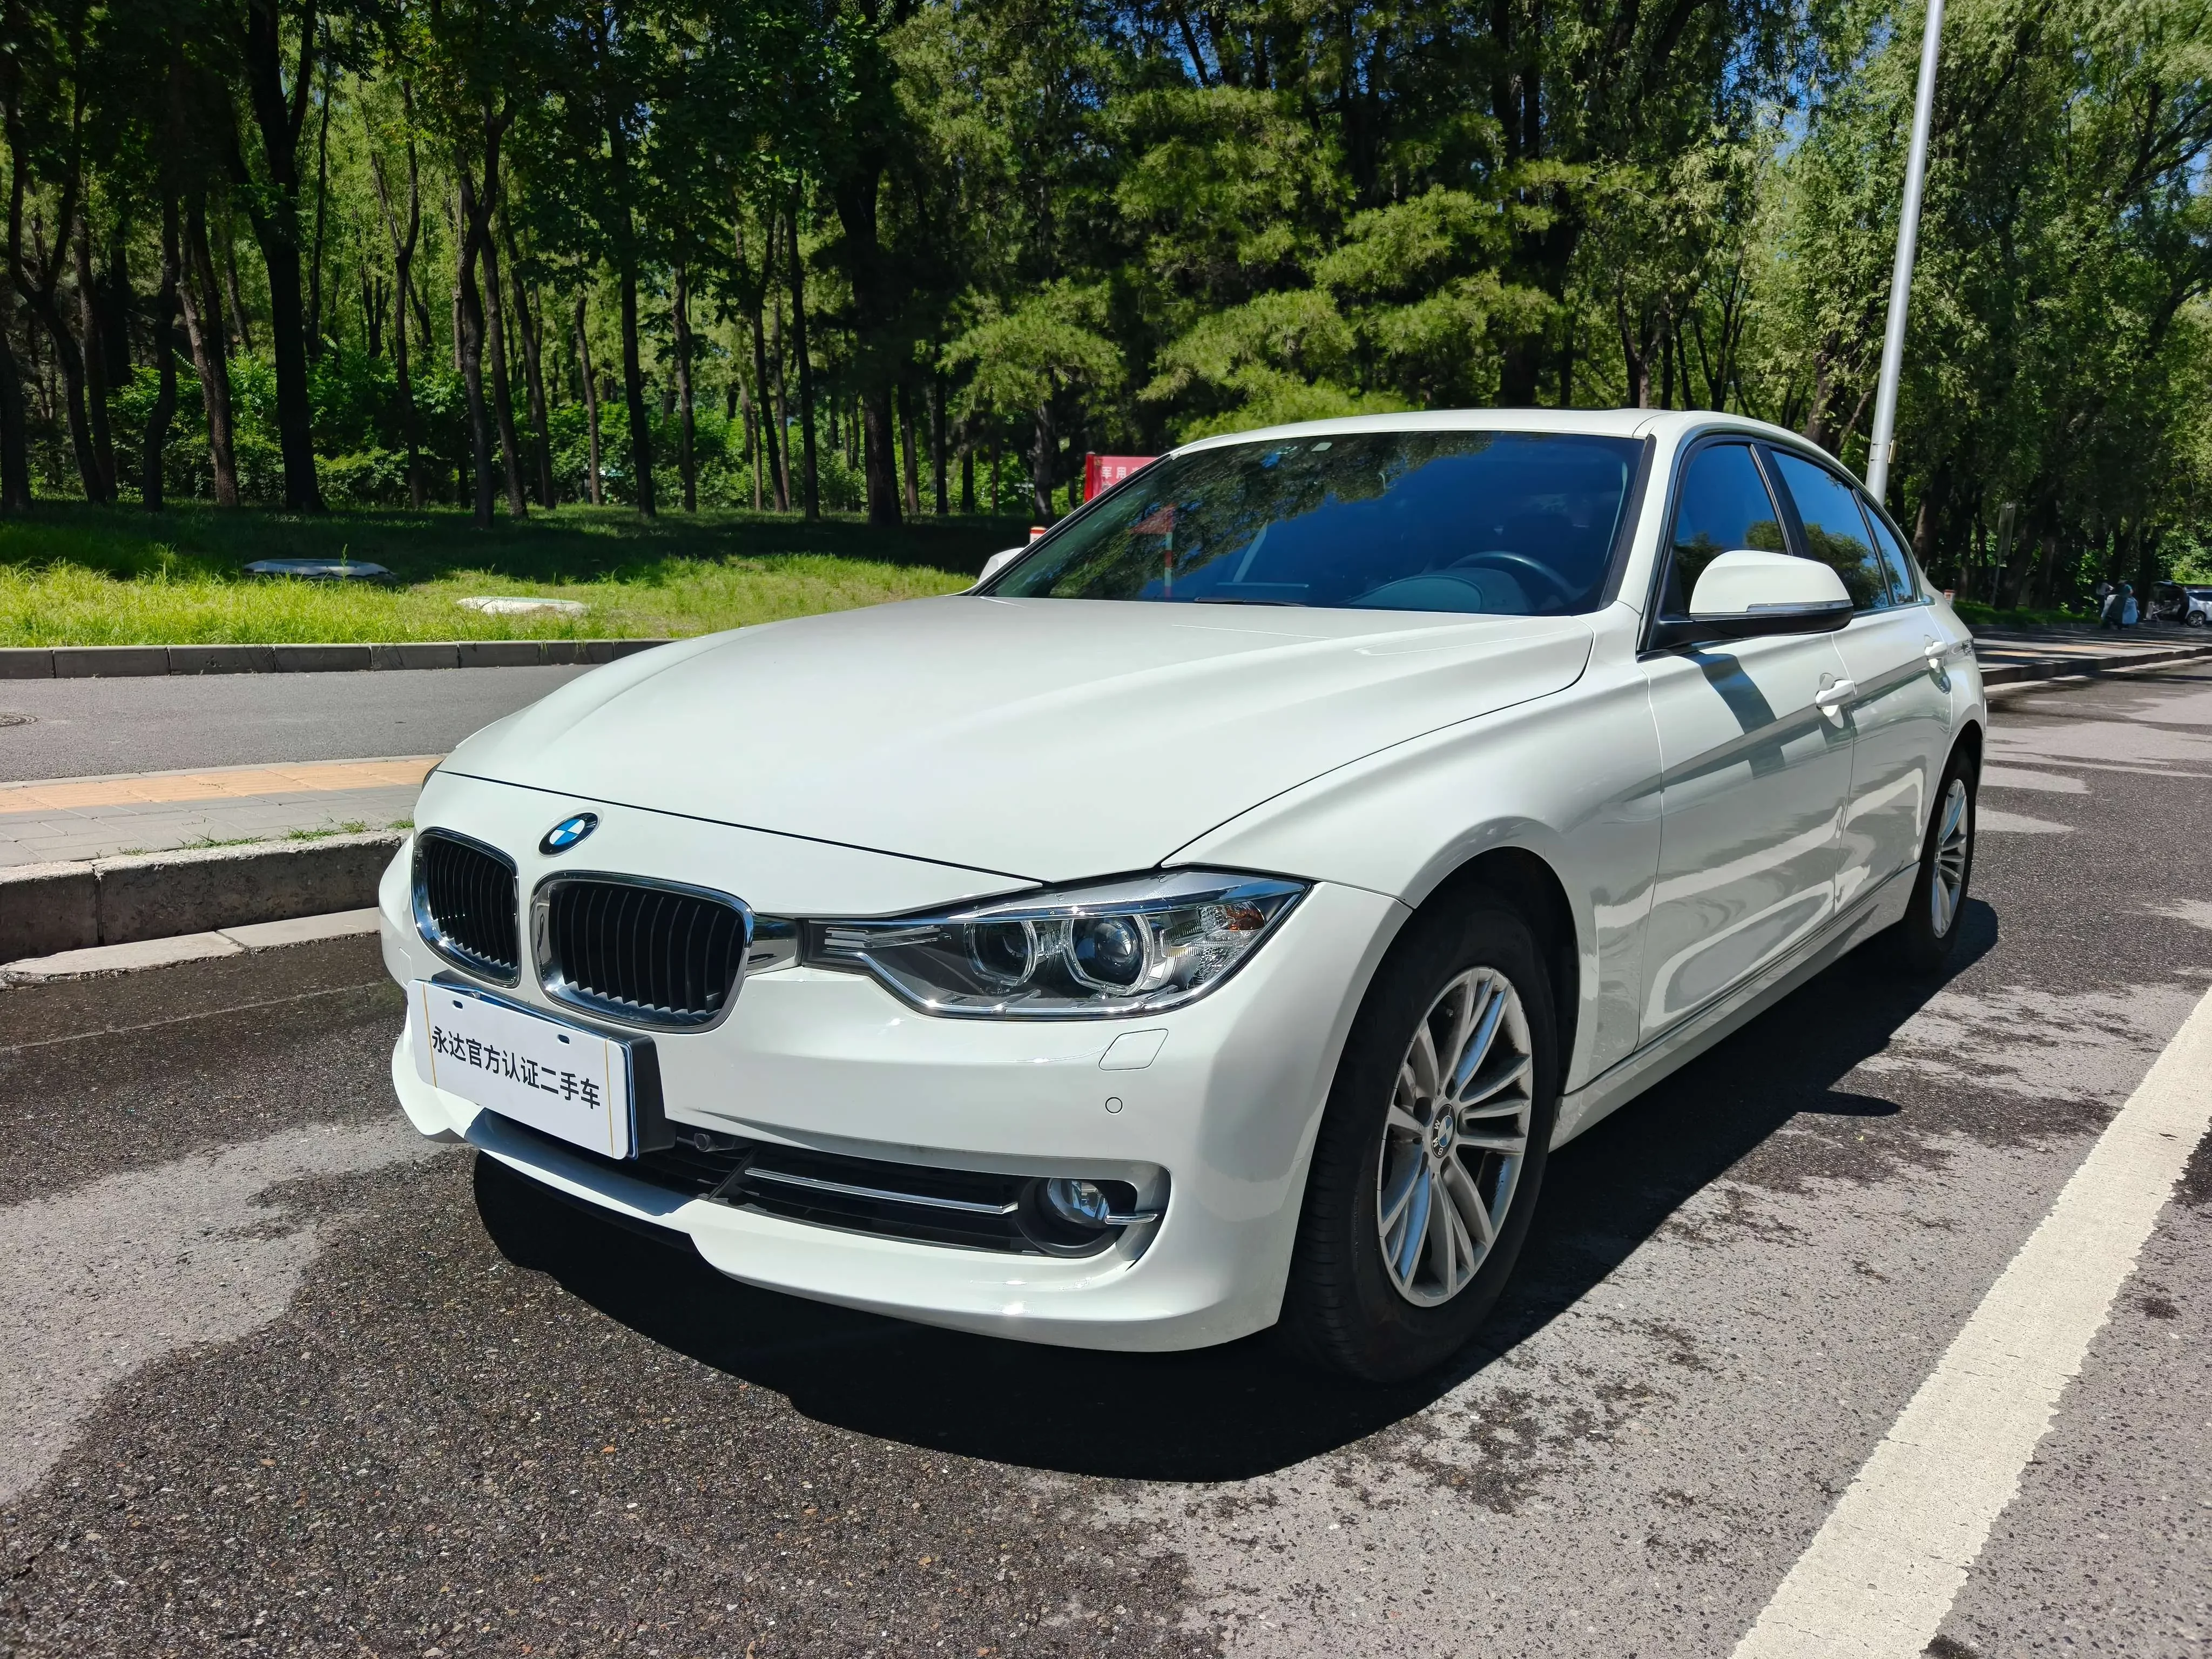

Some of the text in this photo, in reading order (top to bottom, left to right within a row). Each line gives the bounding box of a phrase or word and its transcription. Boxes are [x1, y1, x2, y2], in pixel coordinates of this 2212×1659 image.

[432, 1026, 601, 1109] 永达官方认证二手车
[1433, 1120, 1444, 1155] BMW
